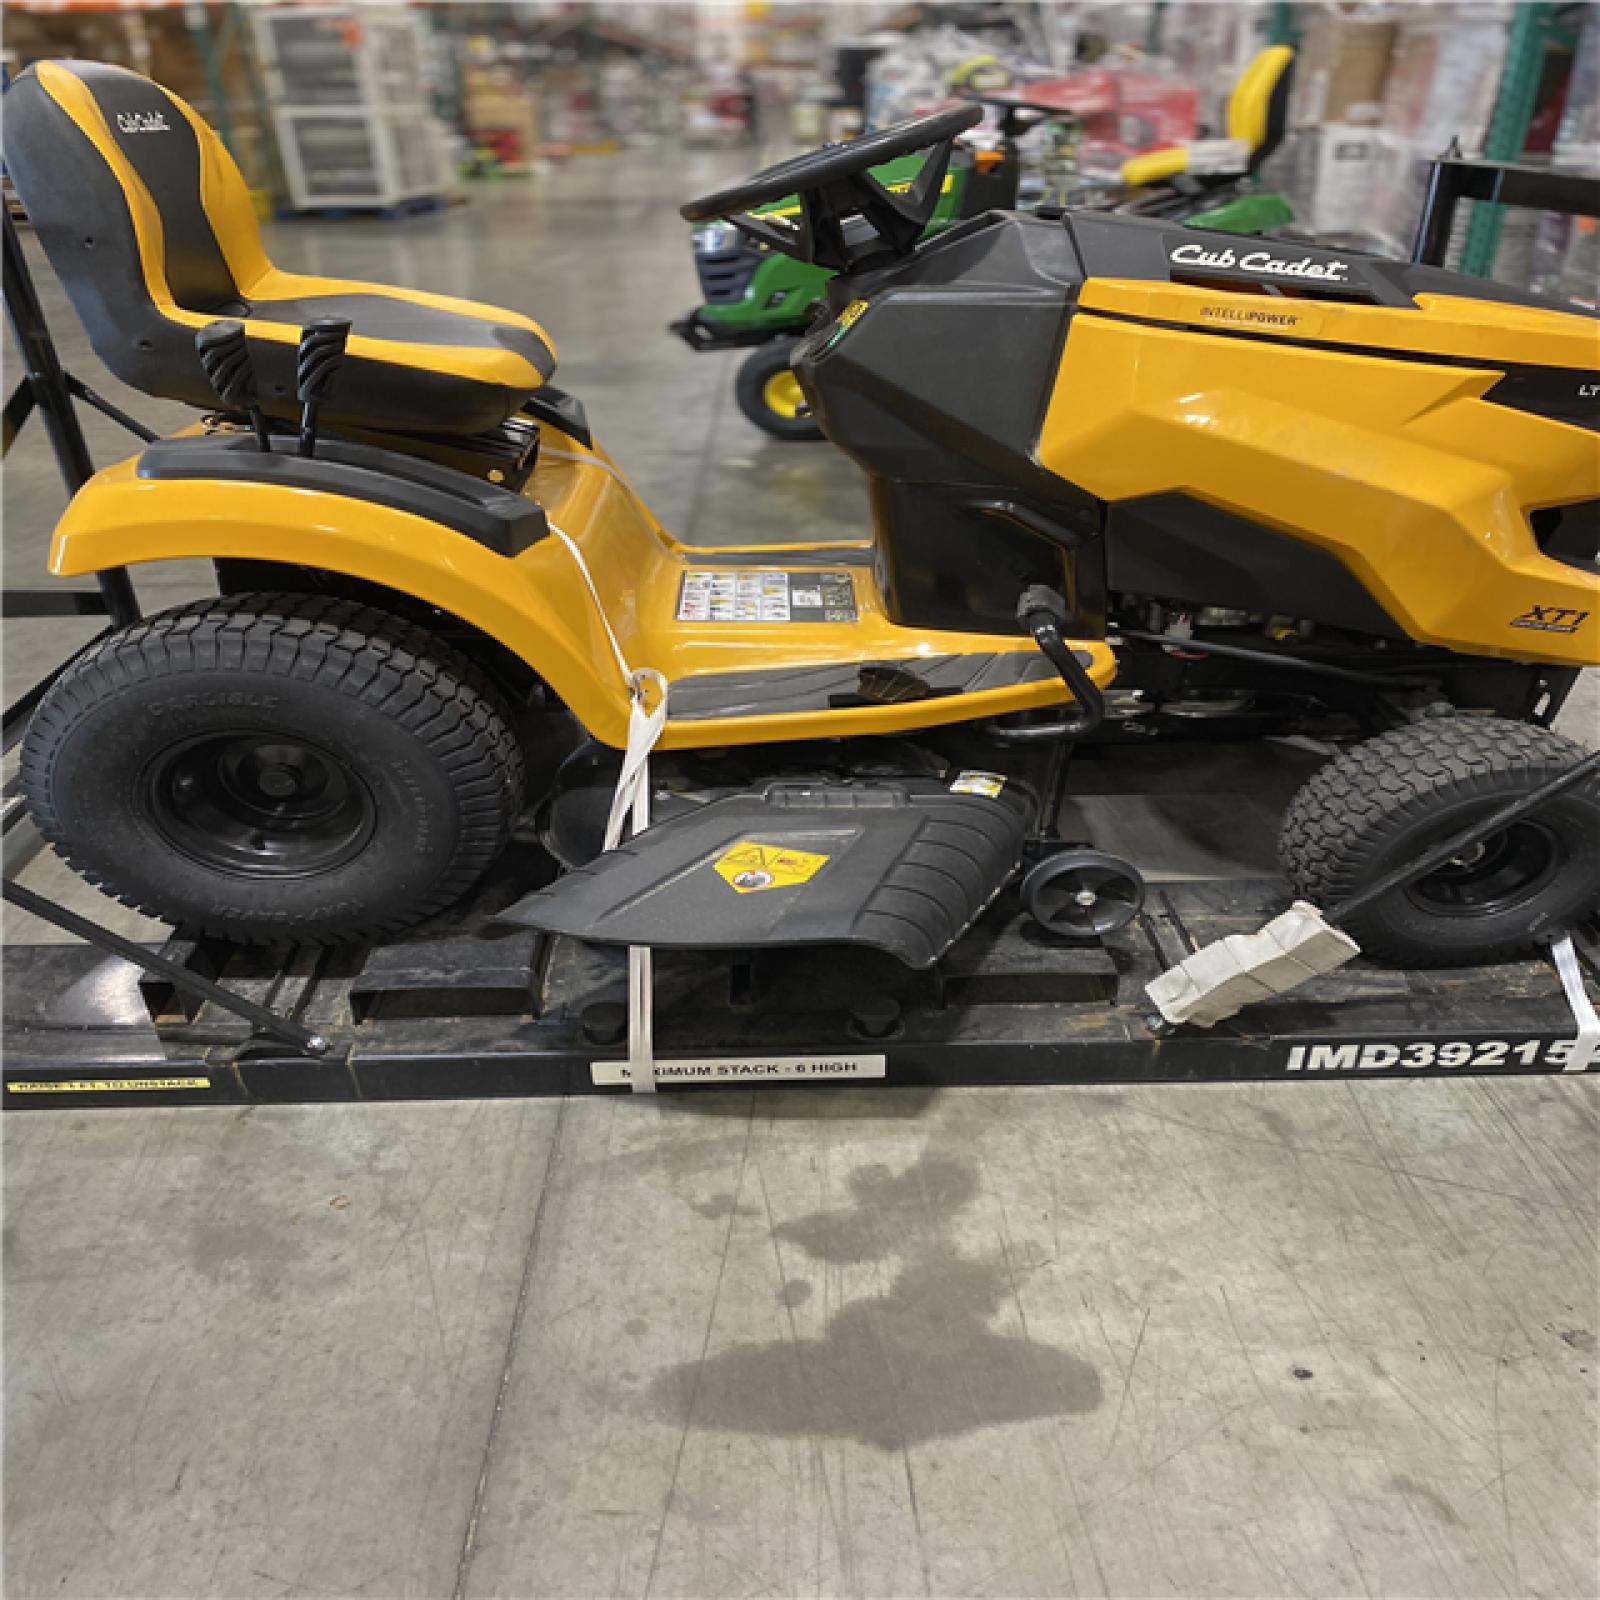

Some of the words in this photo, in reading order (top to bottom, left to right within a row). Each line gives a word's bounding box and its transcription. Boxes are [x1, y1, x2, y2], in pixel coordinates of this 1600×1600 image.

[1169, 244, 1236, 268] Cub
[1239, 252, 1348, 281] Cadet
[1200, 306, 1298, 326] INTELLIPOWER
[717, 1064, 778, 1076] STACK
[812, 1062, 857, 1073] HIGH
